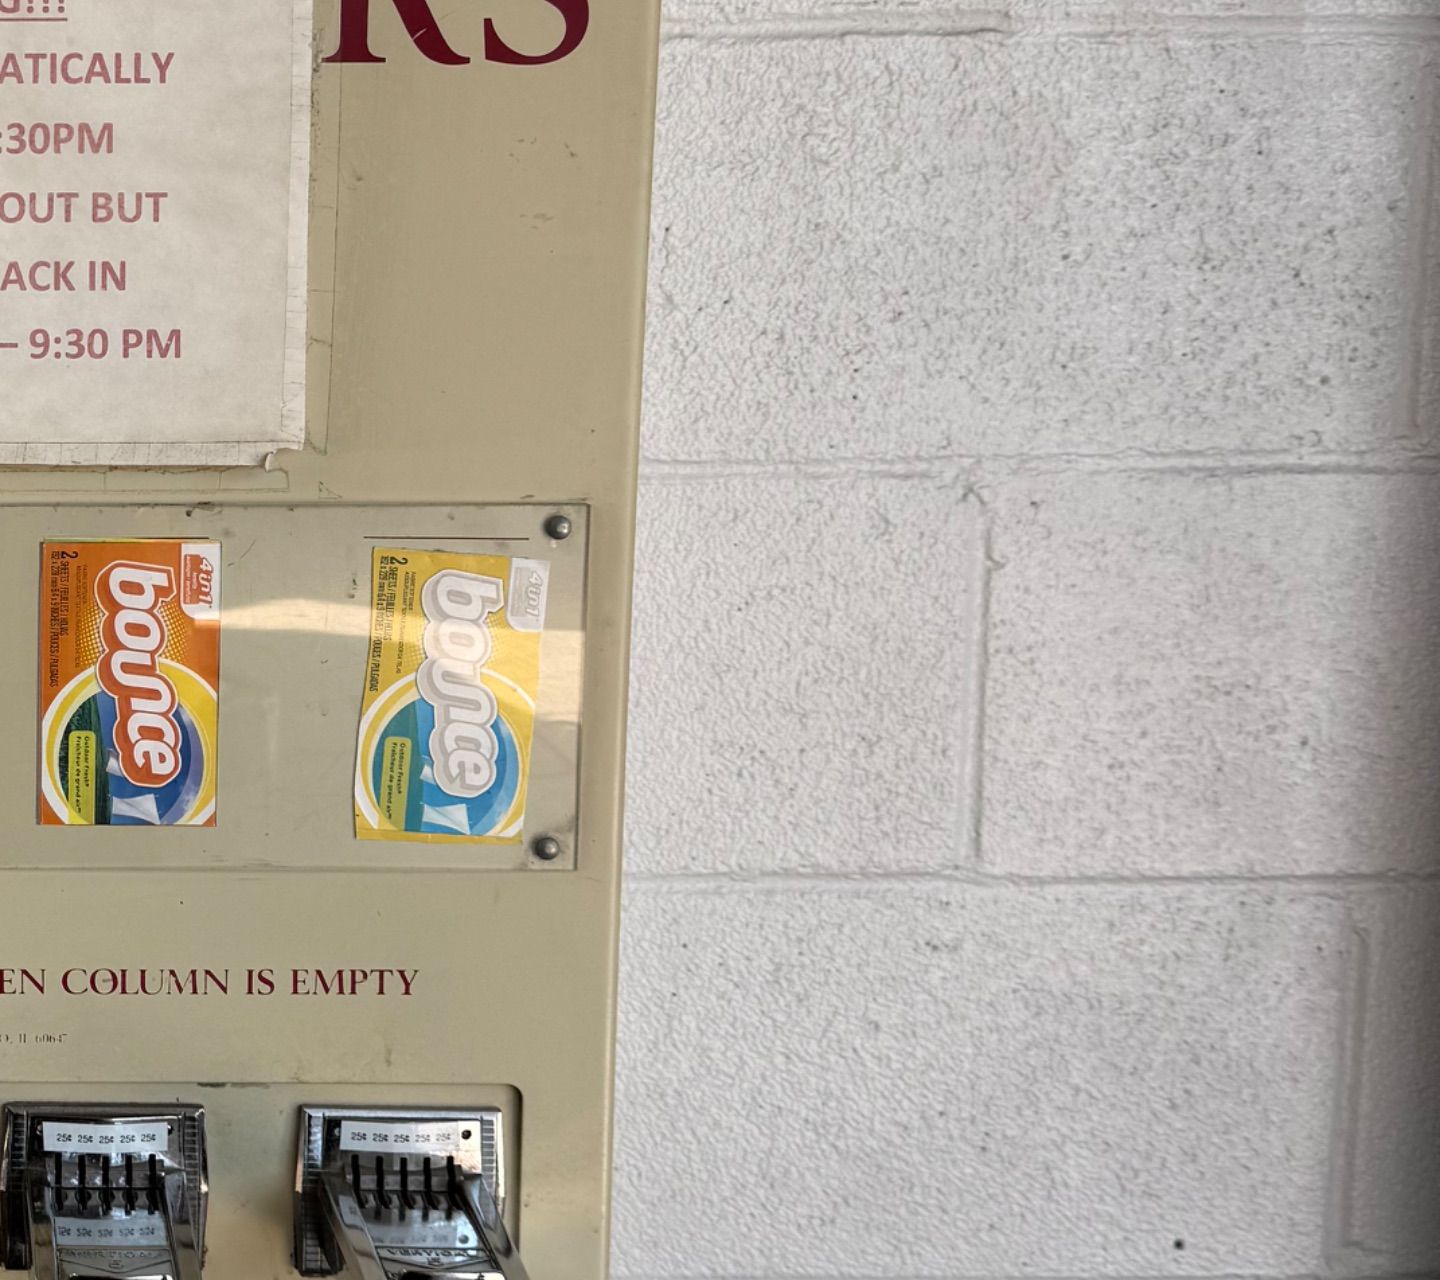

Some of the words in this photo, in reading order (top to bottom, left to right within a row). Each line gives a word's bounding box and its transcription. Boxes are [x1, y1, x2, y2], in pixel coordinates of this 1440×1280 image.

[92, 192, 168, 223] BUT
[89, 261, 126, 291] IN
[30, 328, 108, 359] 9:30
[123, 329, 181, 358] PM
[61, 551, 78, 559] 2
[390, 557, 408, 565] 2
[109, 567, 176, 776] bounce
[431, 575, 498, 789] bounce
[62, 968, 228, 995] COLUMN
[246, 969, 274, 995] IS
[291, 969, 418, 995] EMPTY
